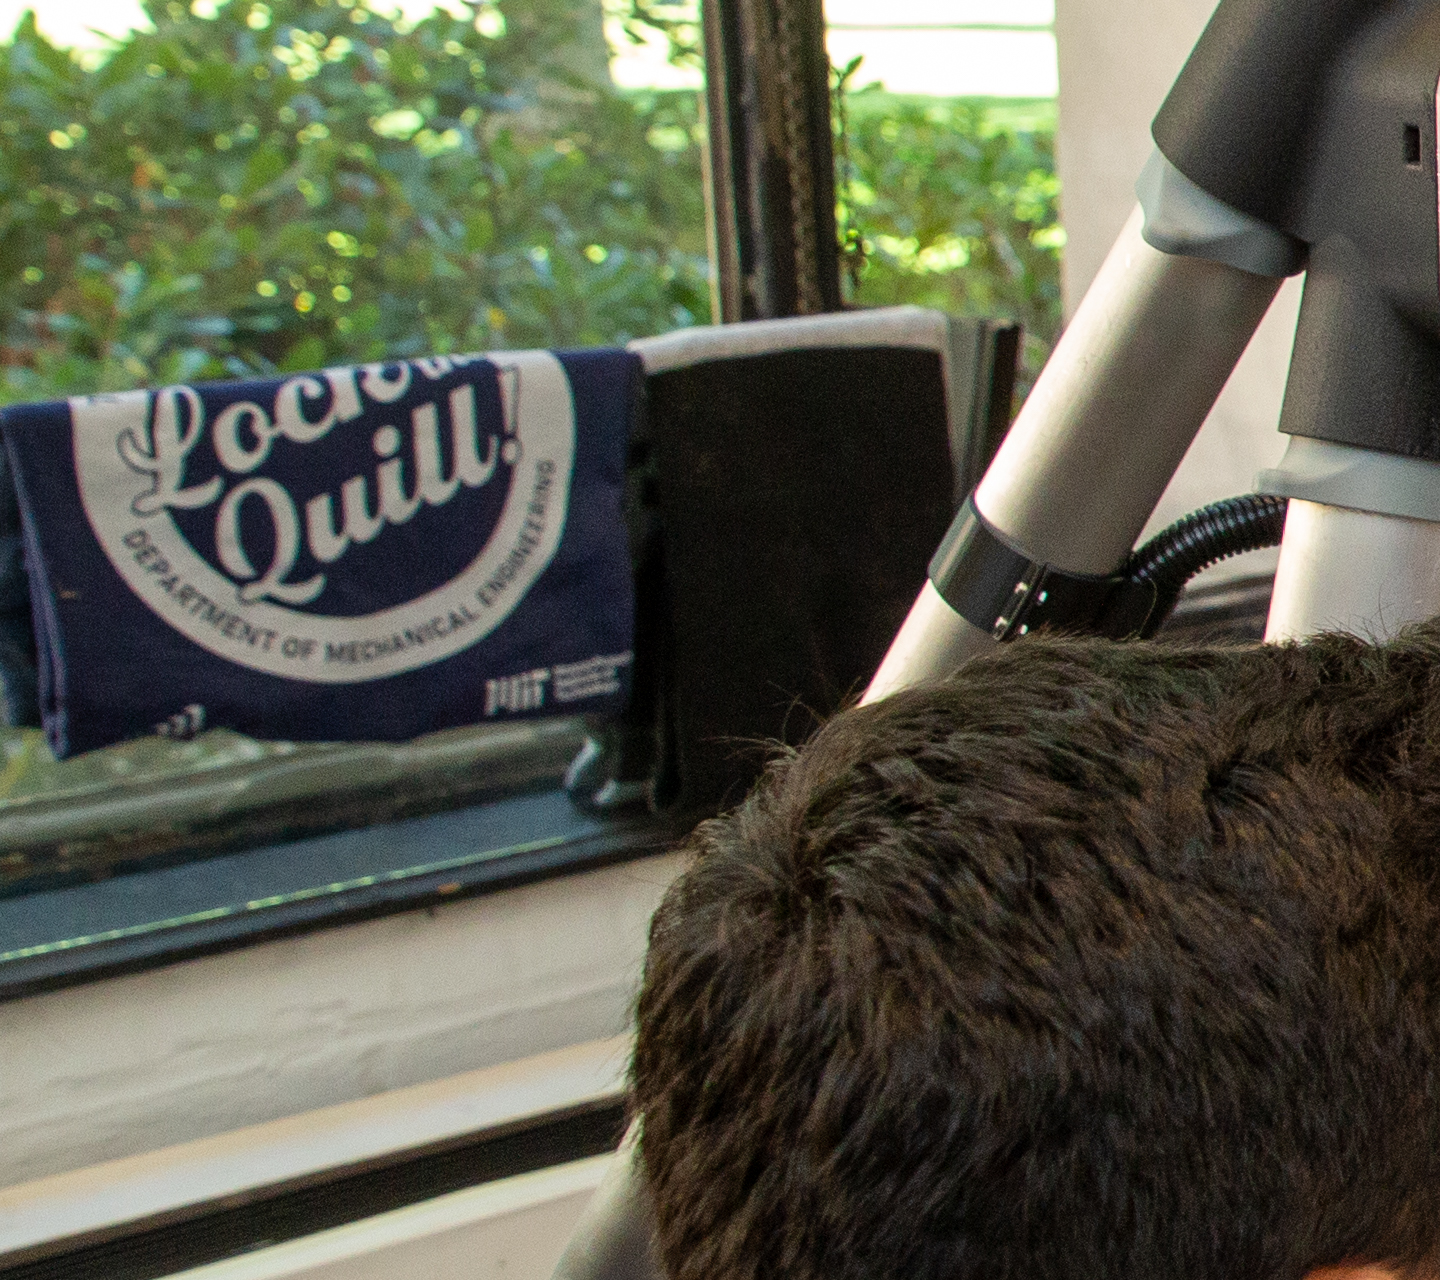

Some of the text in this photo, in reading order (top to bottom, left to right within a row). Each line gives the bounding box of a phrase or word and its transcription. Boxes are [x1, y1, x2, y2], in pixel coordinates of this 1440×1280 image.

[122, 458, 556, 665] DEPARTMENT OF MECHANICAL ENGINEERING
[215, 363, 524, 606] Quill!
